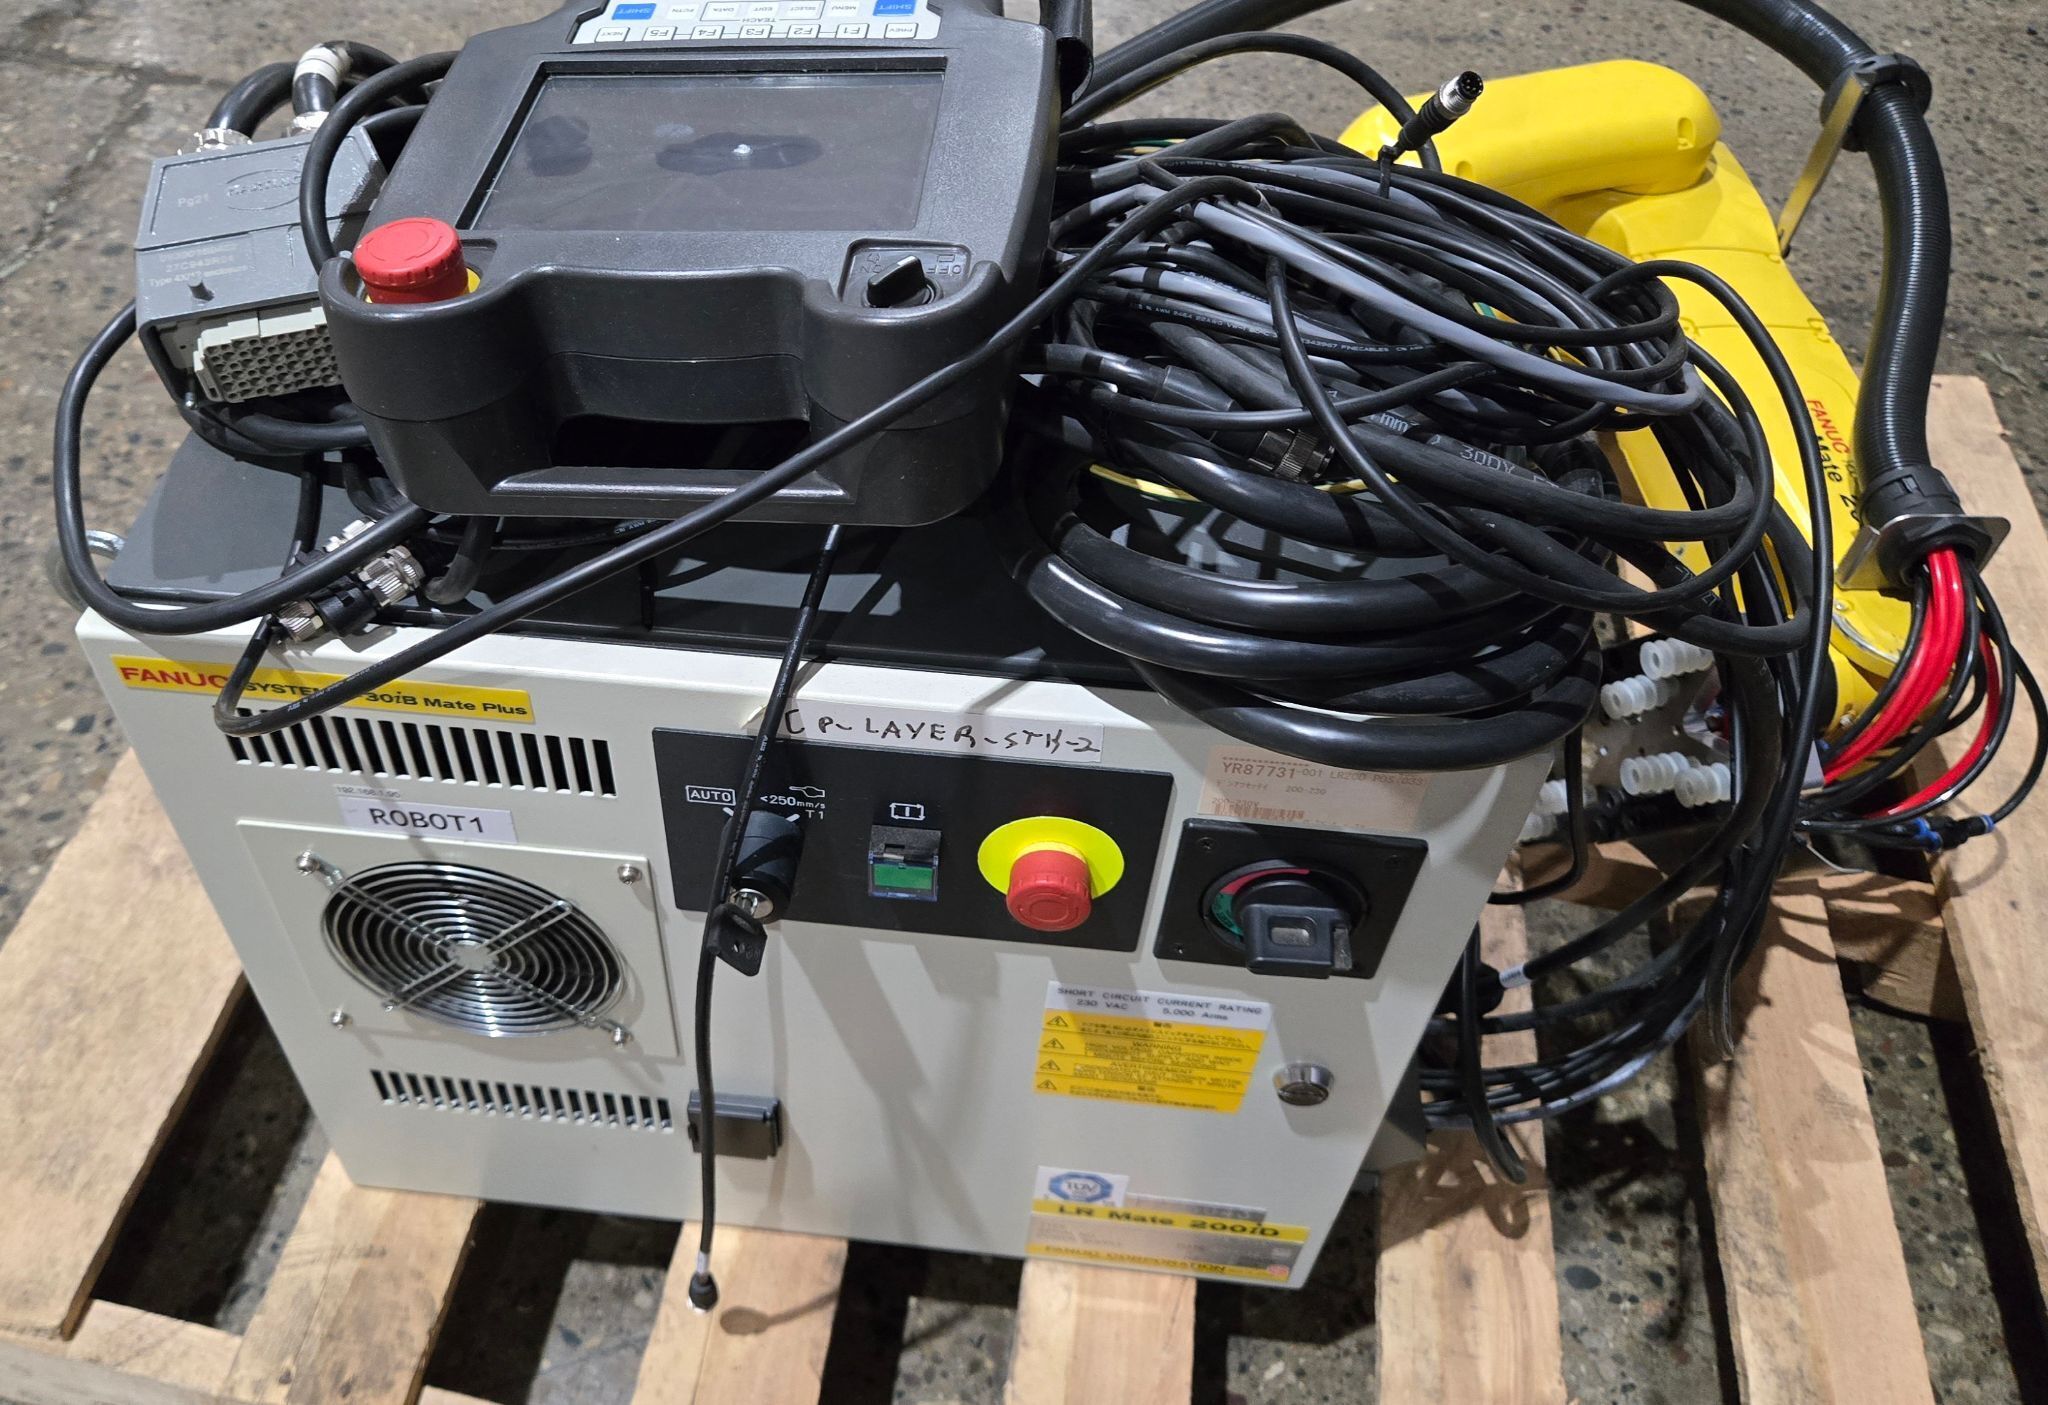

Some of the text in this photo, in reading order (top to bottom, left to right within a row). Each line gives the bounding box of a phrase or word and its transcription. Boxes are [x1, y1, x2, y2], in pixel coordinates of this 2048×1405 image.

[650, 29, 669, 37] F5
[698, 28, 717, 36] F4
[746, 28, 766, 36] F3
[793, 27, 814, 35] F2
[843, 26, 860, 34] F1
[1806, 399, 1850, 454] FANUC
[119, 667, 229, 689] FANUC
[423, 697, 476, 711] Mate
[482, 702, 528, 716] Plus
[690, 789, 731, 802] AUTO
[369, 807, 484, 834] ROBOT1
[1057, 986, 1263, 1015] SHORT CIRCUIT CURRENT RATING
[1076, 998, 1098, 1008] 230
[1105, 1001, 1129, 1010] VAC
[1057, 1204, 1095, 1216] LR
[1107, 1210, 1174, 1226] Mate
